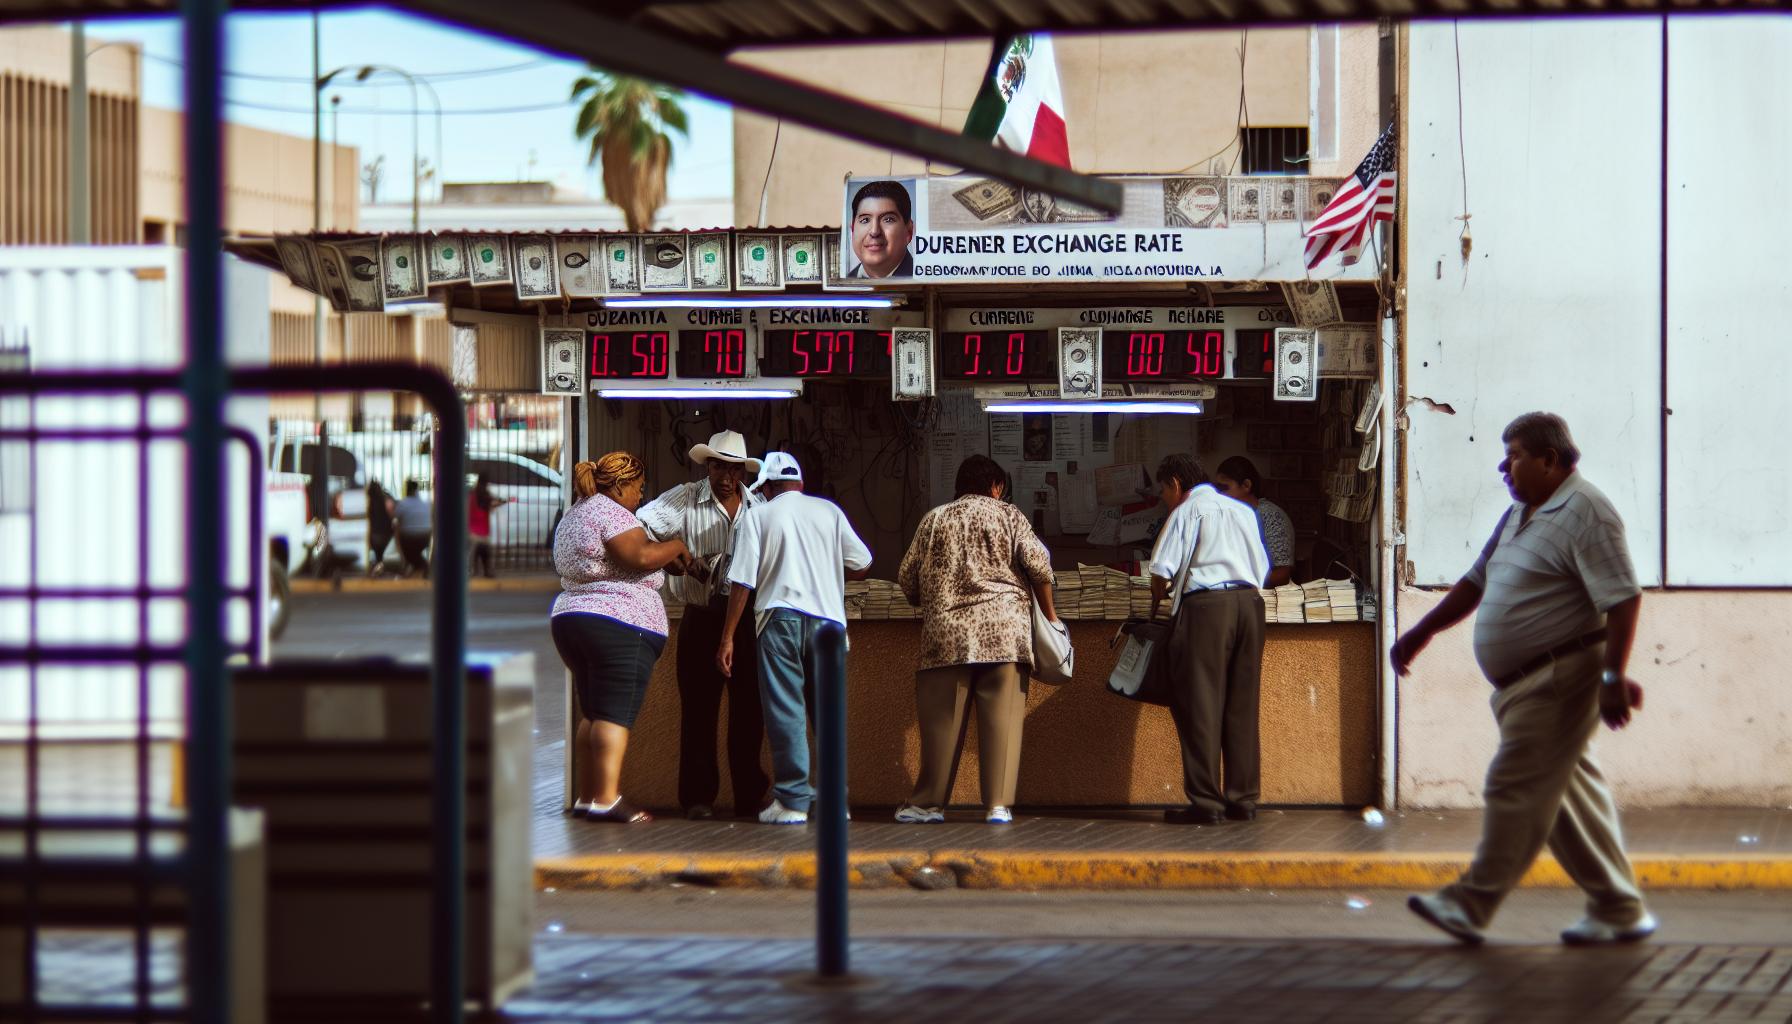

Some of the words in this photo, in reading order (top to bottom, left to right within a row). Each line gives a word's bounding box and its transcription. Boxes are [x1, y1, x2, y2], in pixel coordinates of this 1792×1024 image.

[1013, 233, 1127, 254] EXCHANGE
[1134, 233, 1184, 253] RATE
[631, 333, 668, 376] 50
